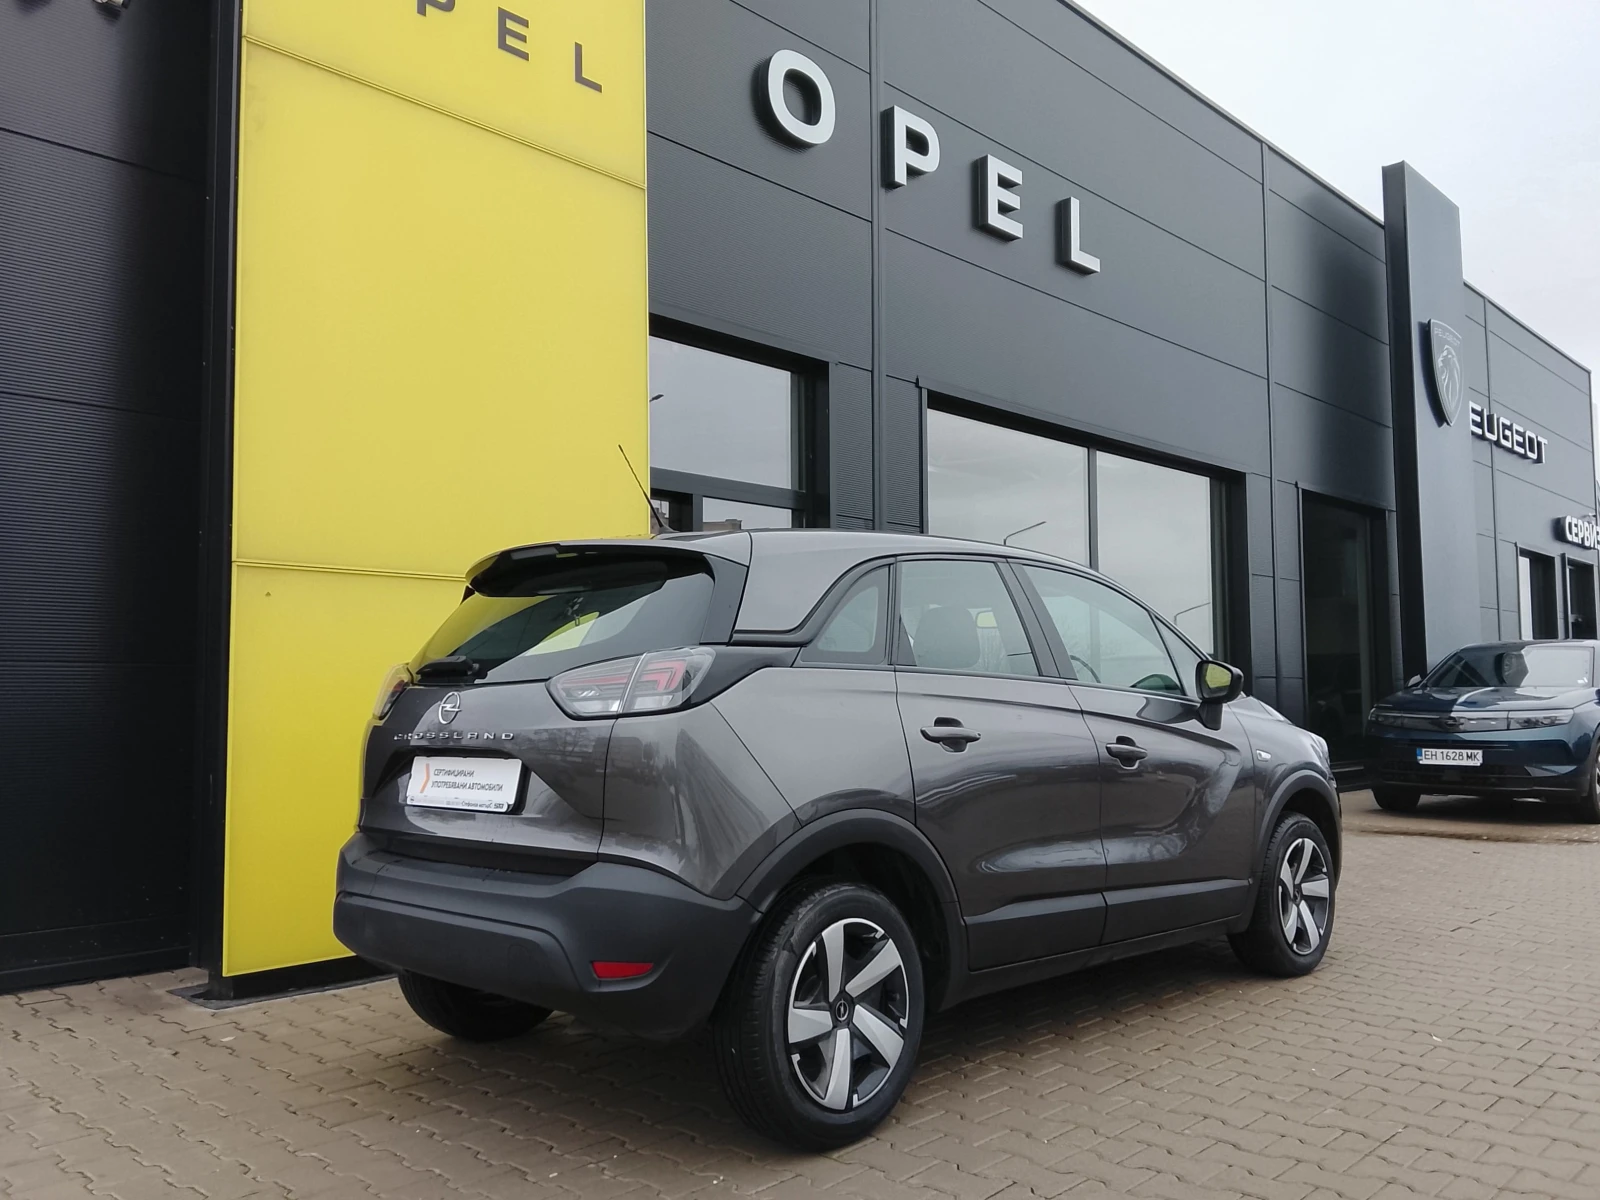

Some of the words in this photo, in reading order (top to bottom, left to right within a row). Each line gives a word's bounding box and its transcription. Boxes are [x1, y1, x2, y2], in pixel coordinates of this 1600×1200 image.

[767, 48, 1101, 274] OPEL
[1434, 327, 1461, 347] PEUGEOT
[393, 731, 515, 741] CROSSLAND
[1423, 750, 1438, 760] EH
[1440, 751, 1464, 761] 1628
[1465, 751, 1480, 762] MK
[433, 768, 475, 778] СЕРТИФИЦИРАНИ
[431, 780, 468, 790] УПОТРЕБЯВАНИ
[467, 782, 504, 792] АВТОМОБИЛИ
